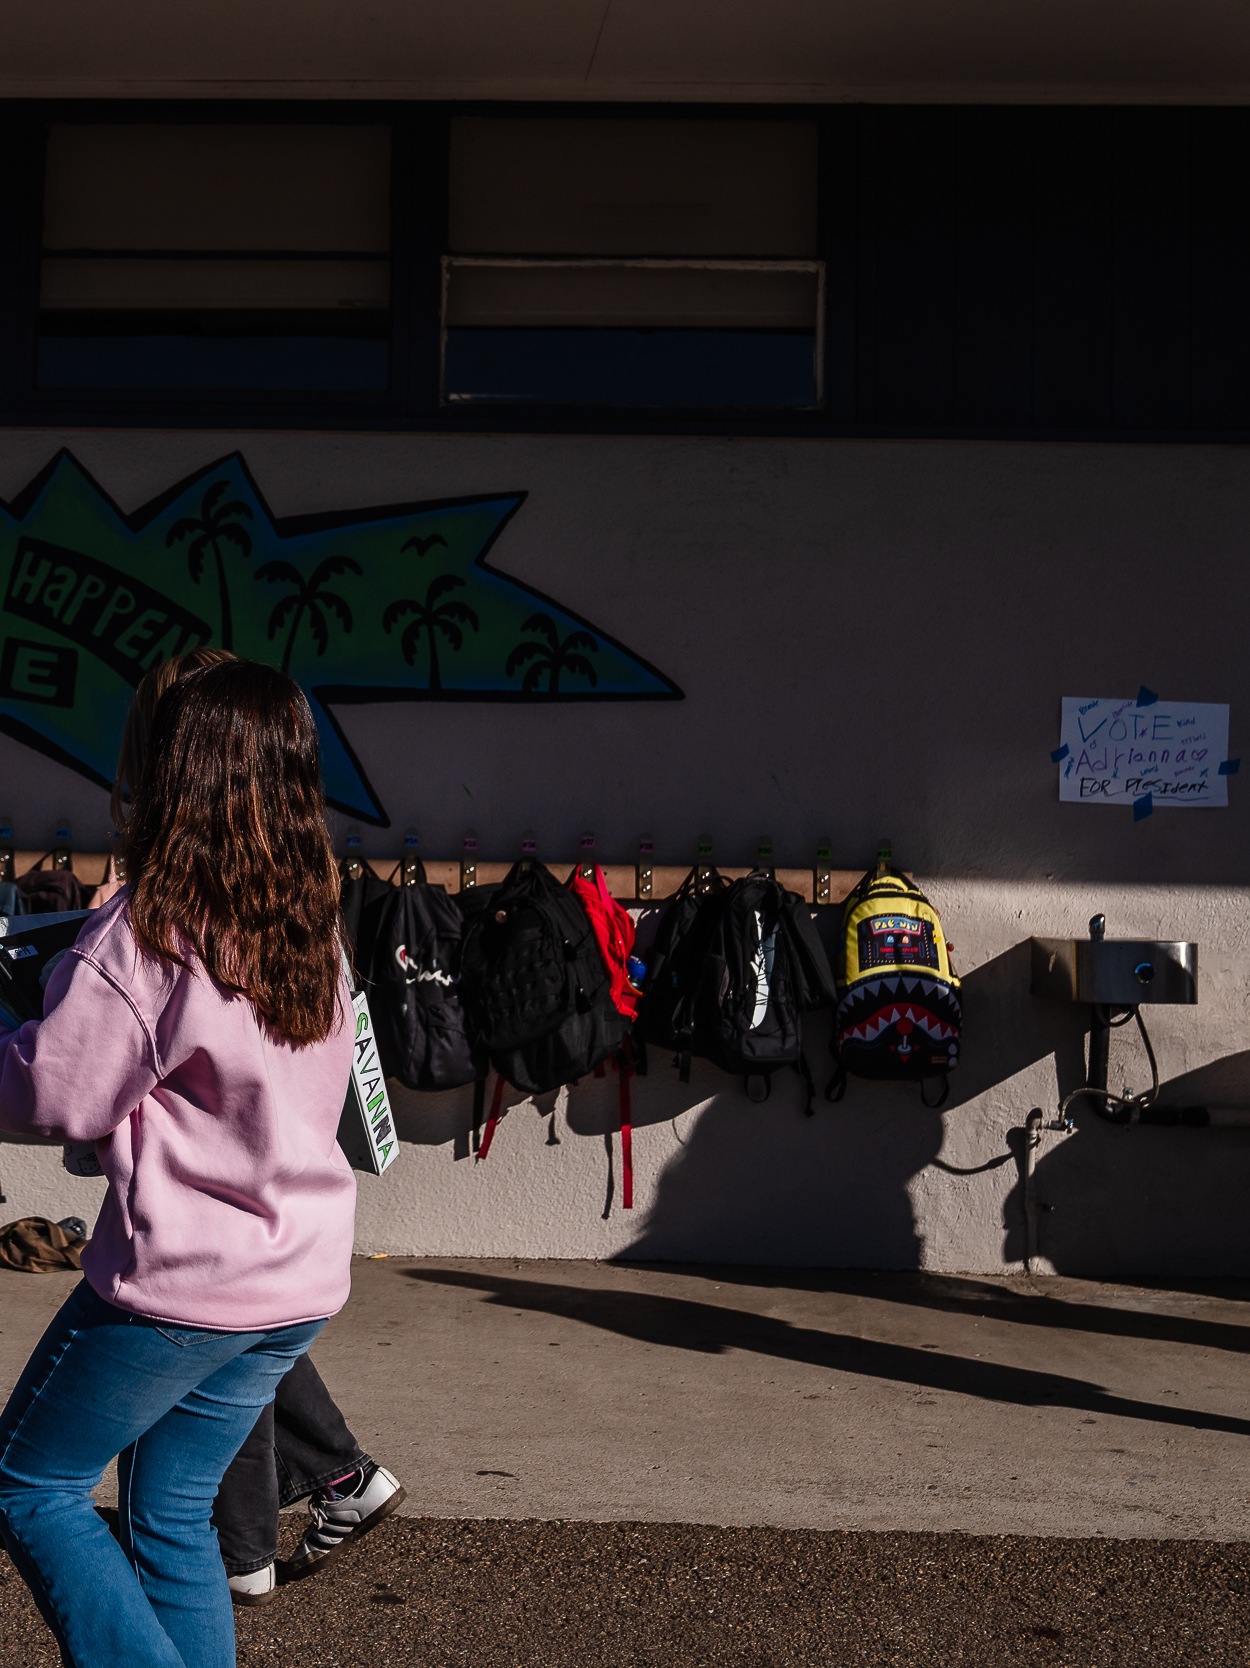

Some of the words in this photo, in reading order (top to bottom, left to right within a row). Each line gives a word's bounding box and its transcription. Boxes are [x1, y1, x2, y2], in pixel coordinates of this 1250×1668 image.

[1077, 713, 1174, 743] VOTE
[1080, 776, 1112, 798] FOR
[354, 1012, 394, 1169] SAVANNA
